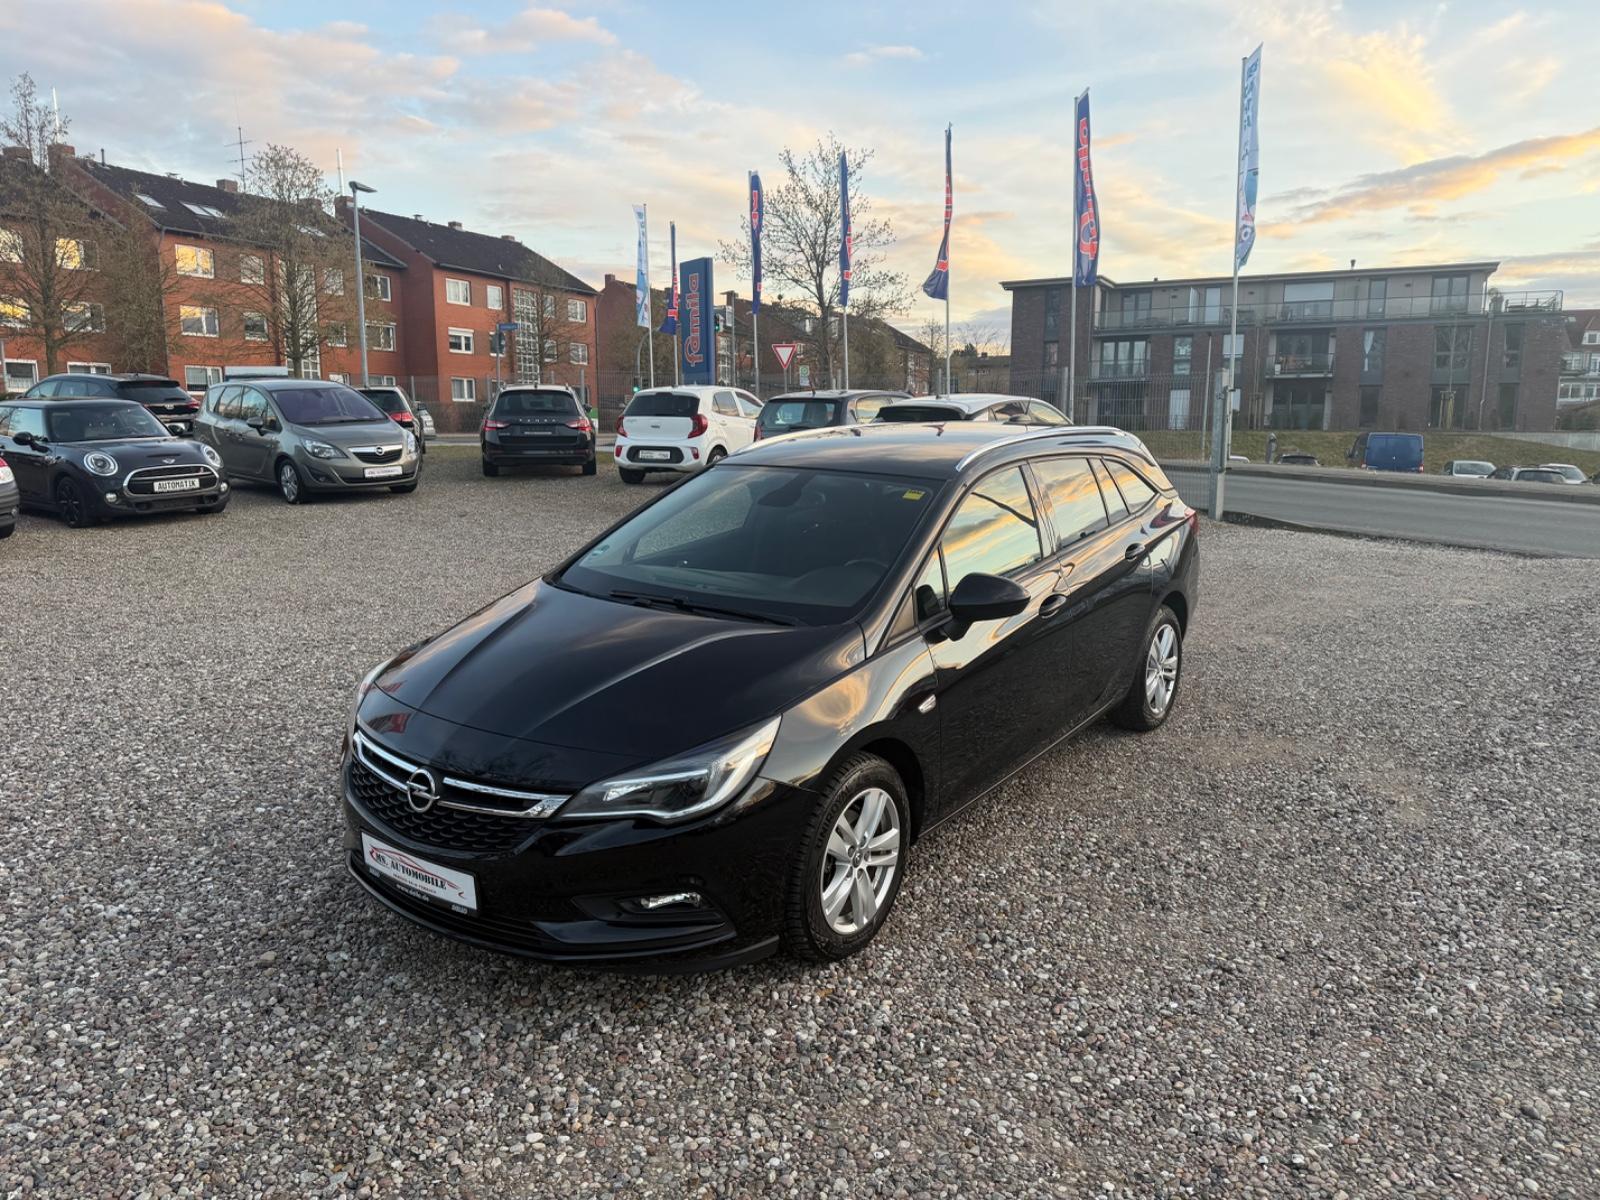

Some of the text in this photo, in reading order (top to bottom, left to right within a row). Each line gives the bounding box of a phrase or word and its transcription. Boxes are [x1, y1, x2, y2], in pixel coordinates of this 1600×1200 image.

[684, 273, 704, 367] famila
[157, 479, 196, 490] AUTOMATIK
[391, 860, 447, 890] AUTOMOBILE
